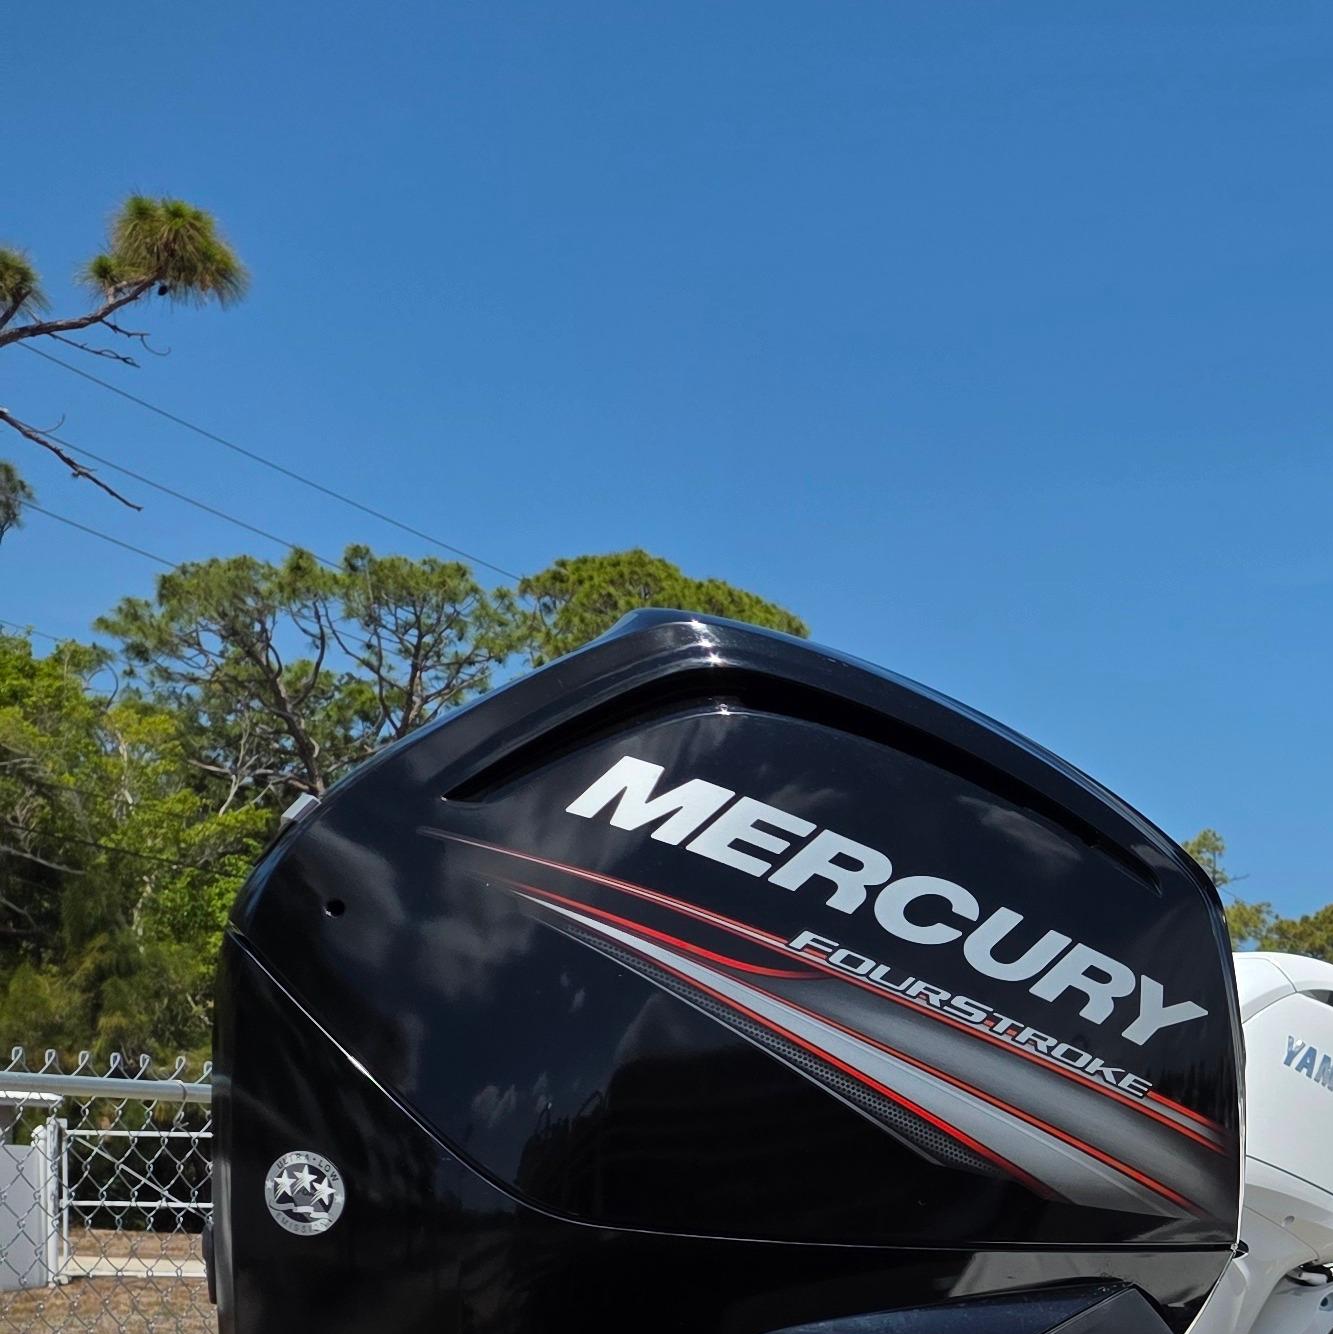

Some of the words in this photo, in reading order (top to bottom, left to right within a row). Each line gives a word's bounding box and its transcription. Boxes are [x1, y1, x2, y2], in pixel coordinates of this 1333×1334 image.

[565, 755, 1208, 1046] MERCURY
[786, 930, 1153, 1100] FOURSTROKE
[318, 1159, 339, 1182] LOW
